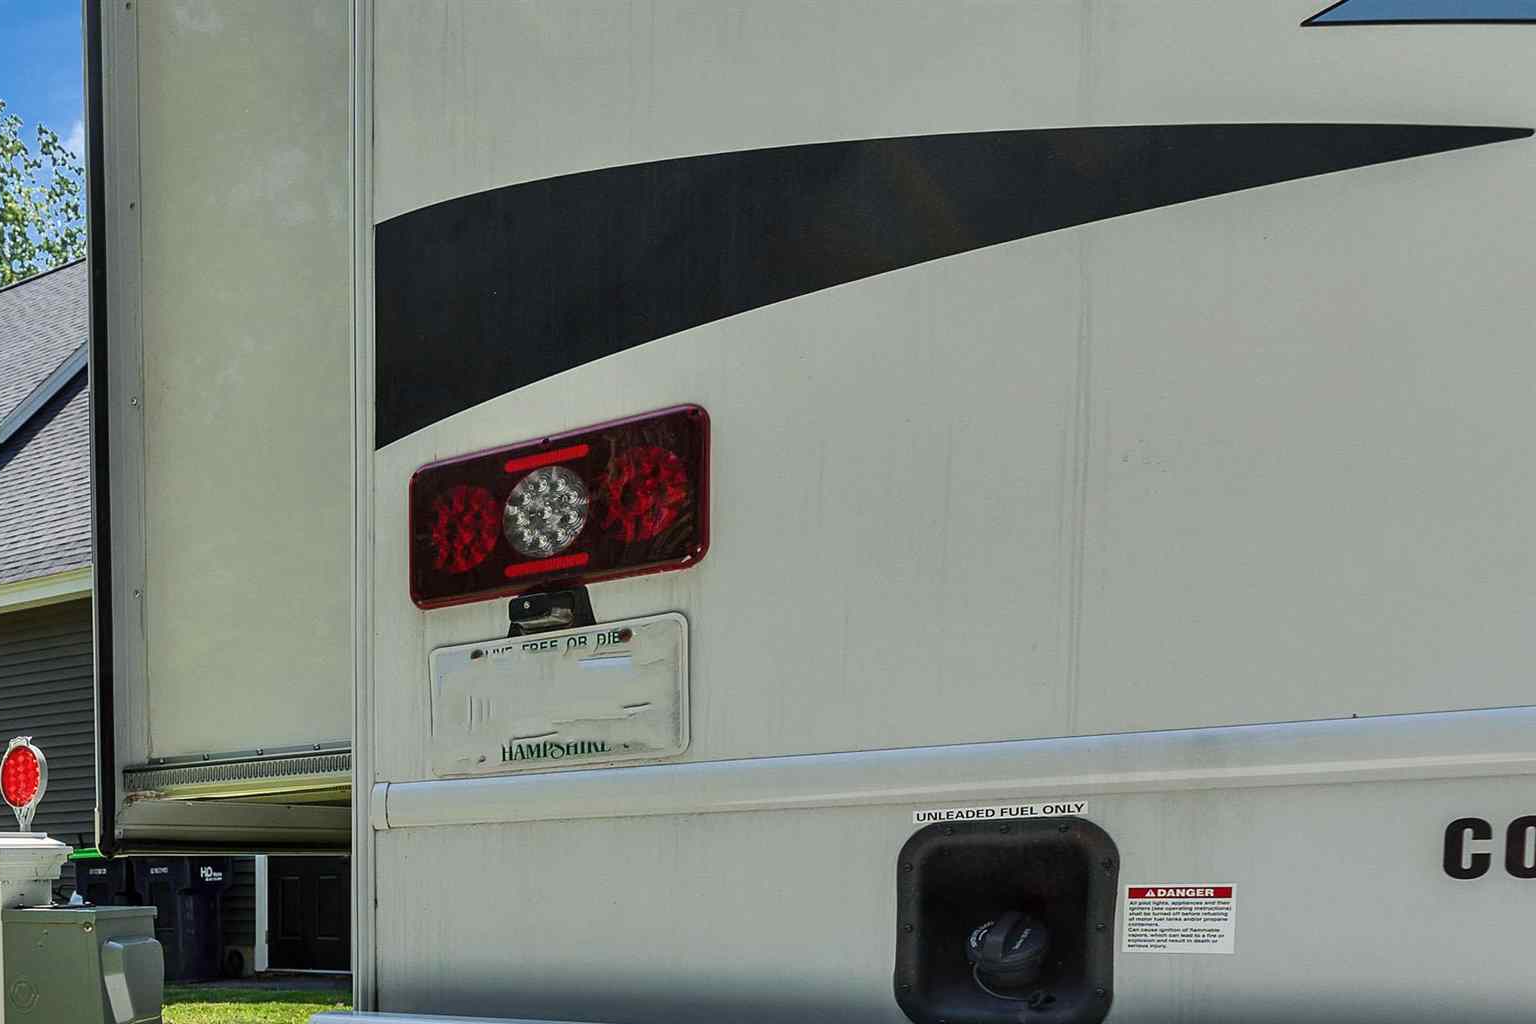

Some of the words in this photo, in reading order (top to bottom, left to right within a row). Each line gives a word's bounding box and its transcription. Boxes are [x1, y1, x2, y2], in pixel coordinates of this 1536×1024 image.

[916, 808, 996, 822] UNLEADED
[1000, 805, 1038, 817] FUEL
[1042, 802, 1086, 815] ONLY
[1157, 888, 1215, 898] DANGER
